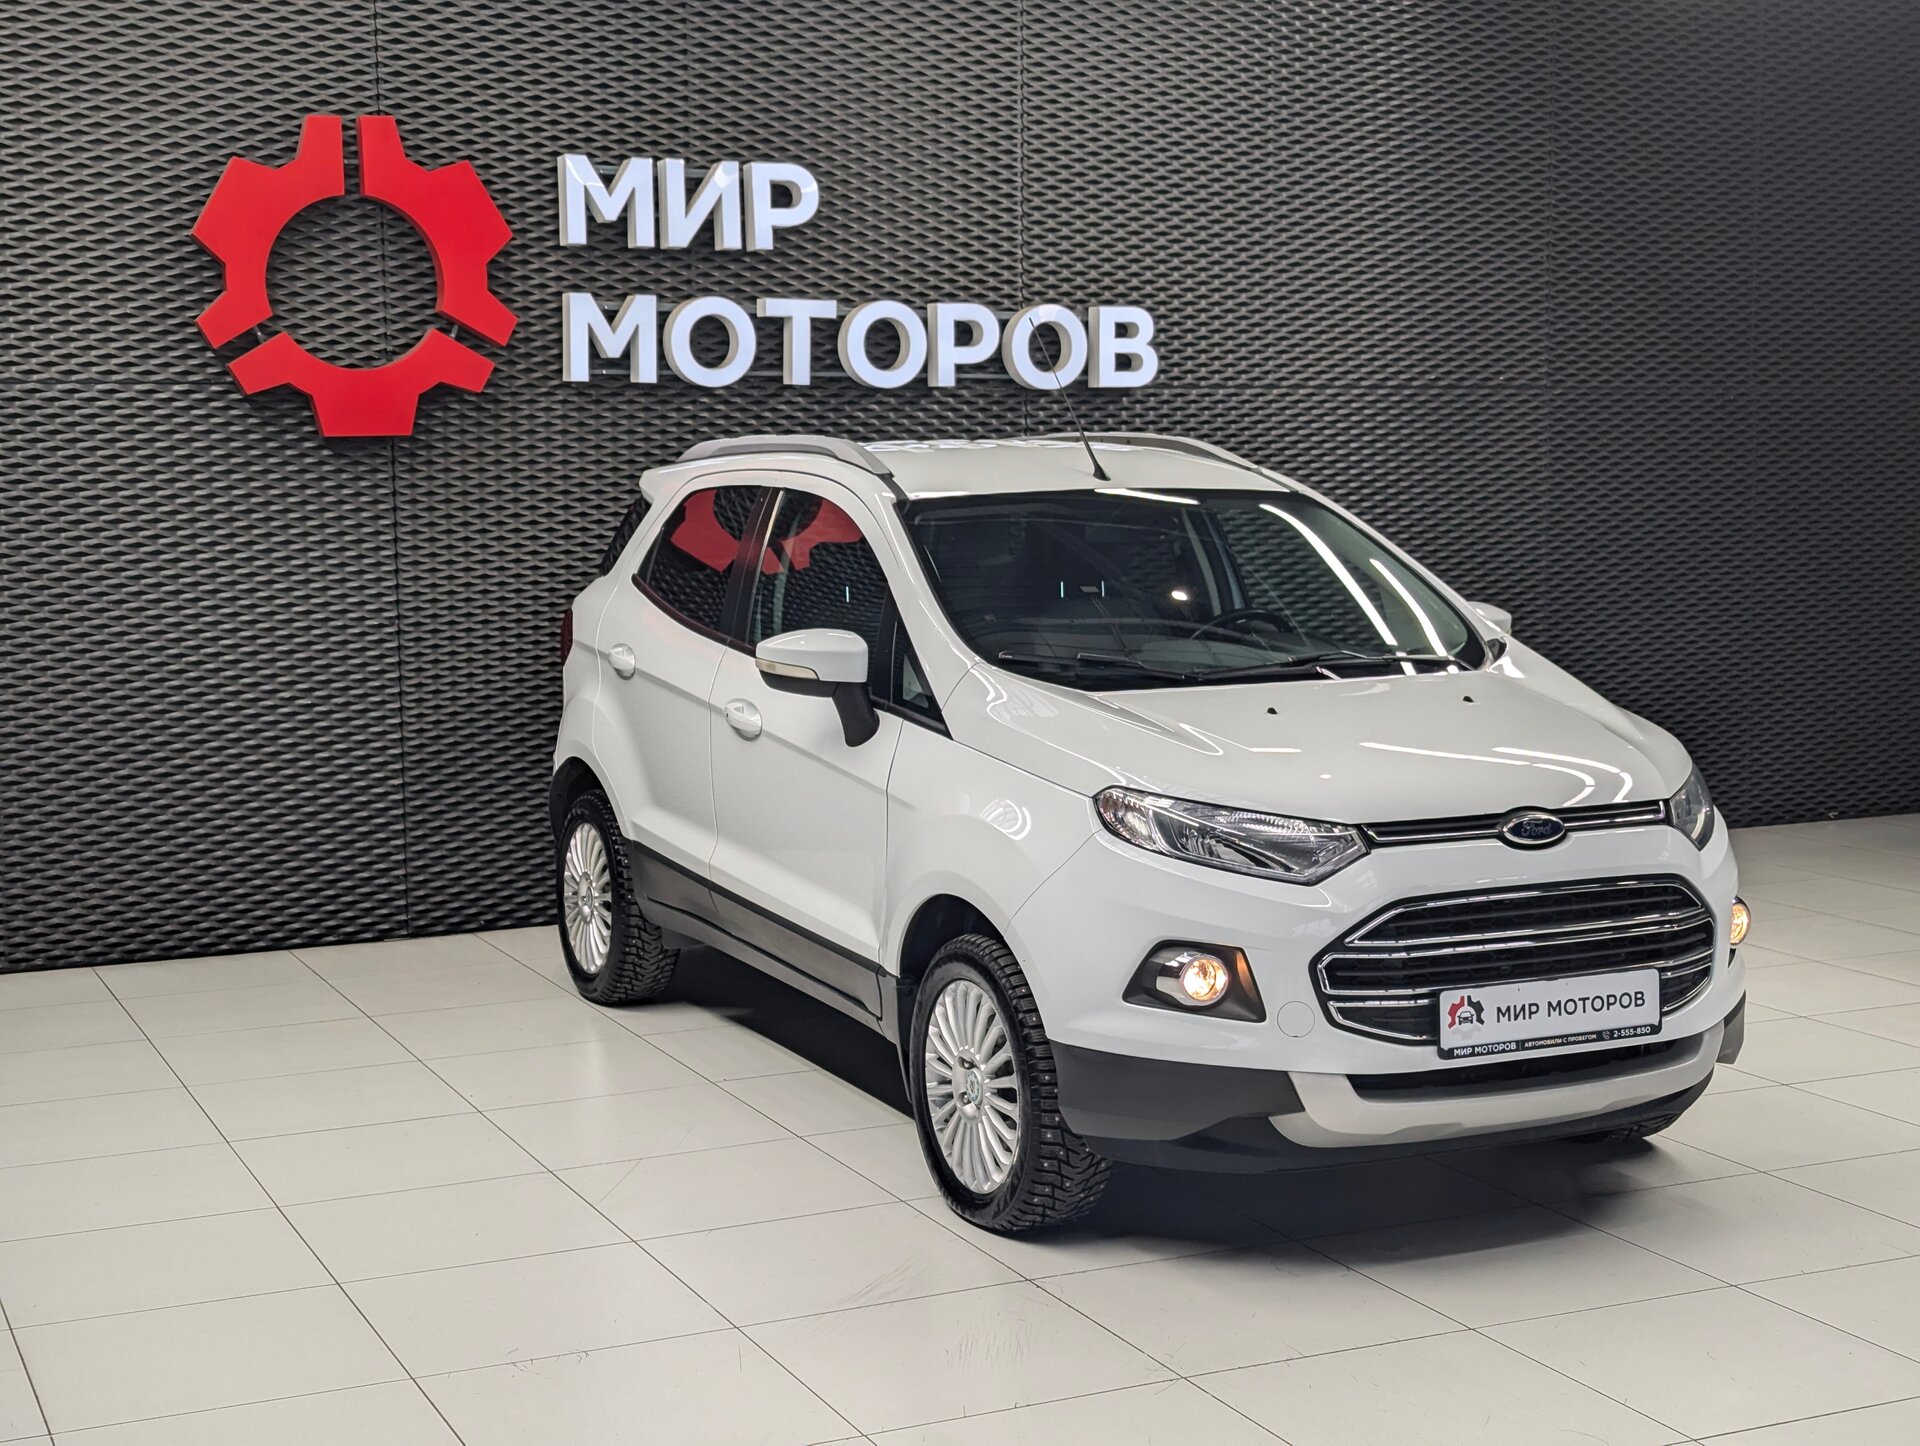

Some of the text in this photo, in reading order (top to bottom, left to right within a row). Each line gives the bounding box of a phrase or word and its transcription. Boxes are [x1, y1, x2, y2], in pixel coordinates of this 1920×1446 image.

[557, 153, 819, 252] МИР
[562, 291, 1159, 389] МОТОРОВ
[1521, 820, 1552, 837] Ford
[1496, 991, 1646, 1024] МИР МОТОРОВ
[1613, 1026, 1651, 1038] 2-555-850
[1453, 1042, 1517, 1057] МИР МОТОРОВ
[1524, 1037, 1562, 1048] АВТОМОБИЛИ
[1568, 1034, 1597, 1043] ПРОБЕГОМ
